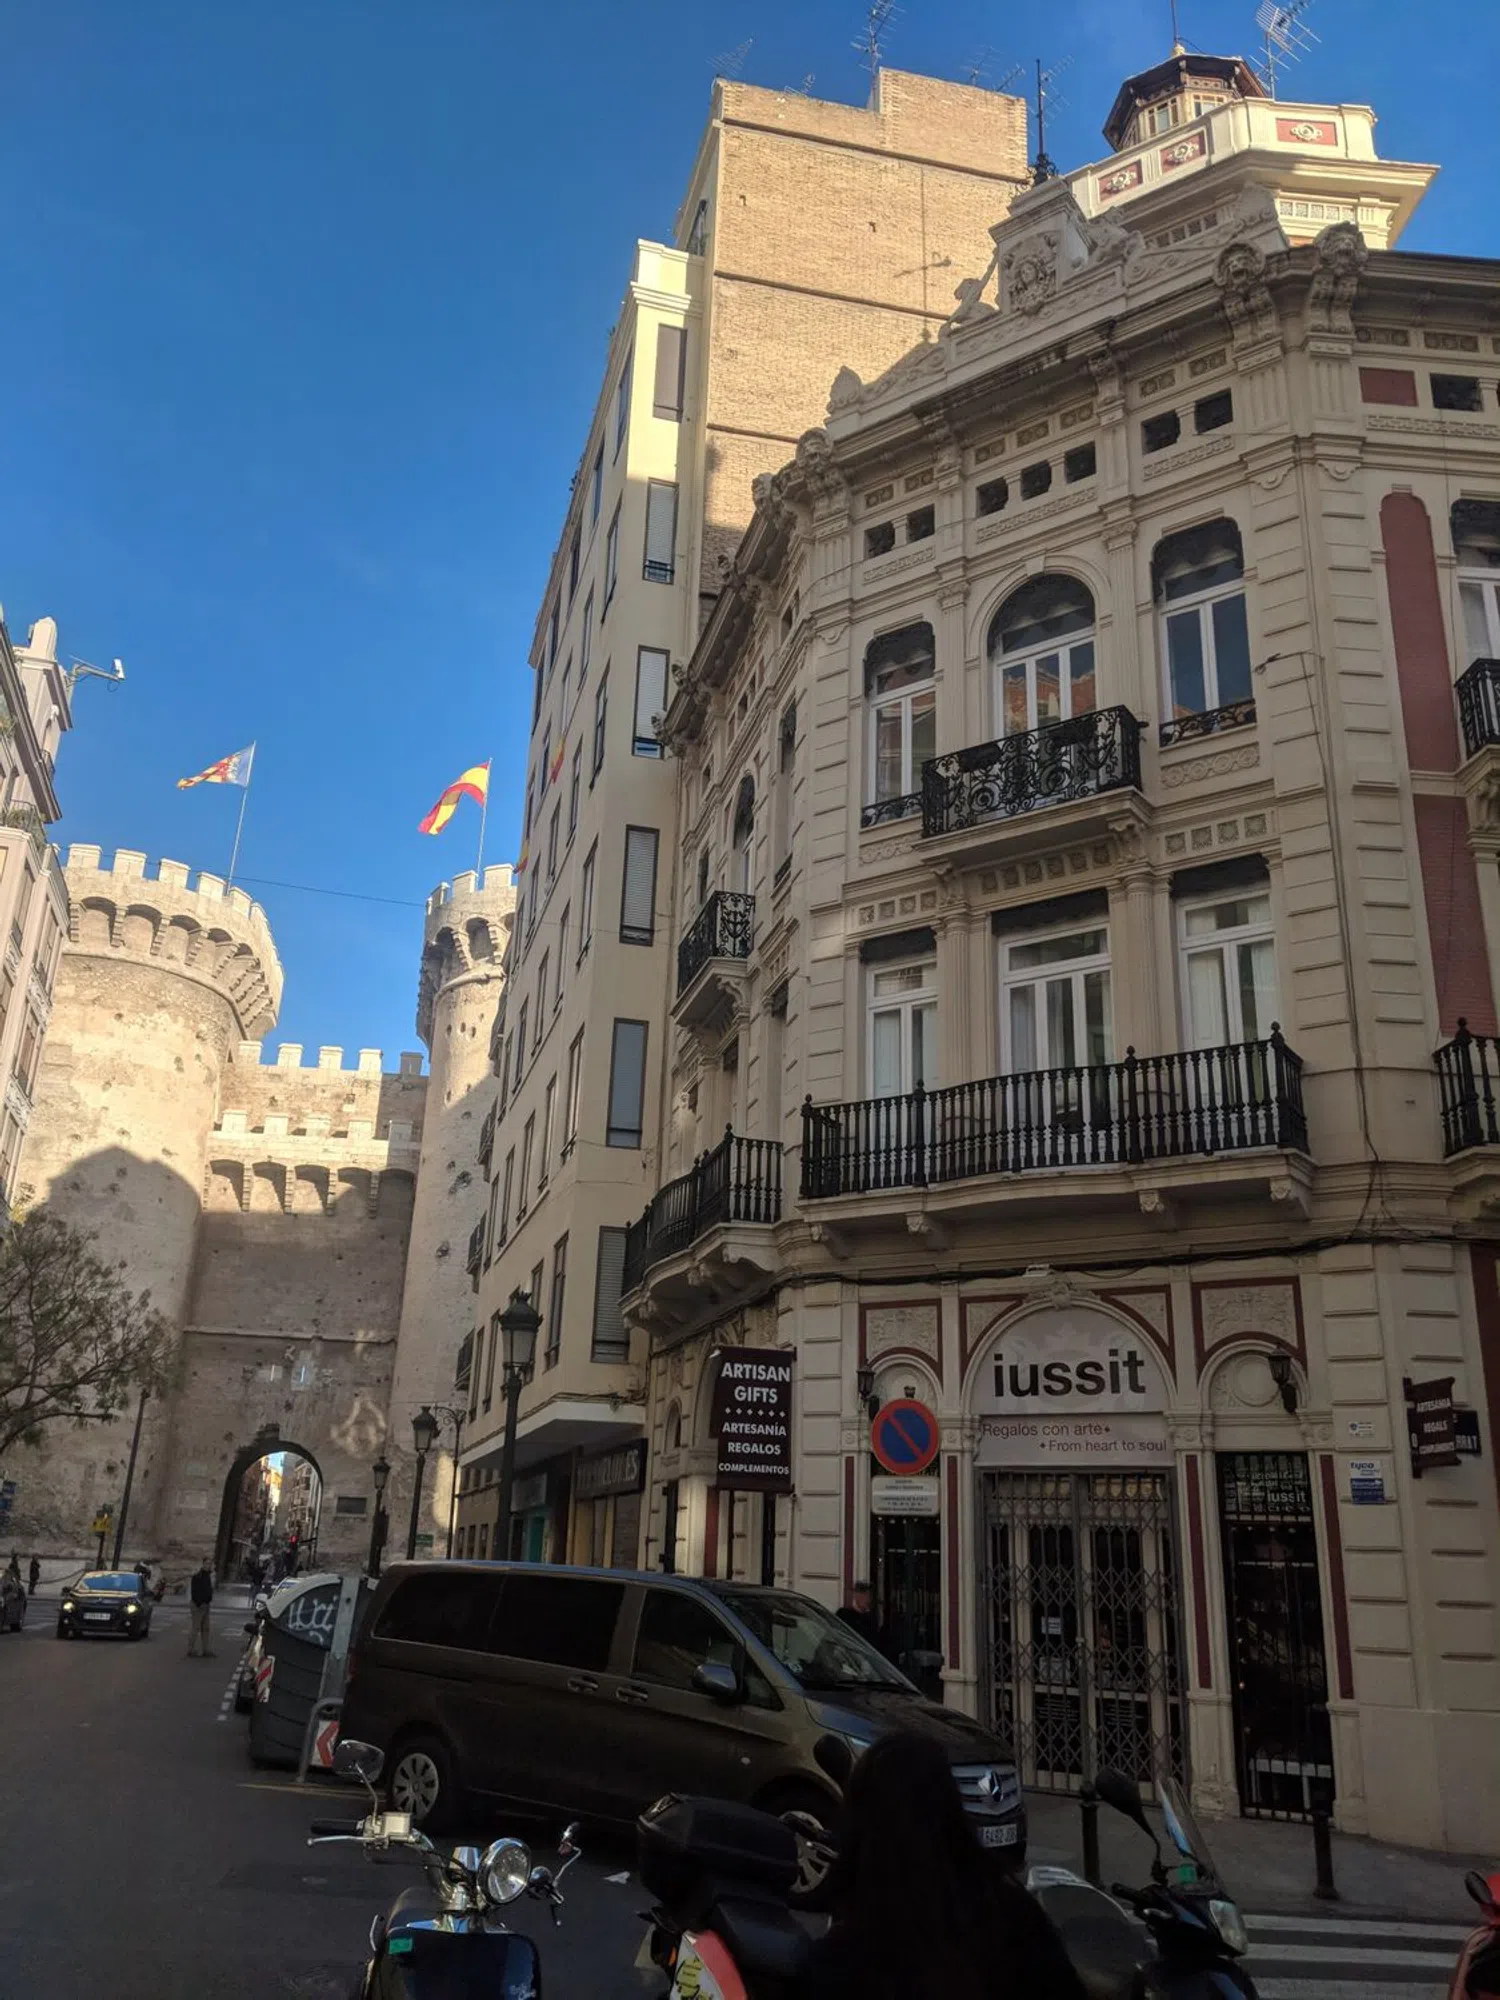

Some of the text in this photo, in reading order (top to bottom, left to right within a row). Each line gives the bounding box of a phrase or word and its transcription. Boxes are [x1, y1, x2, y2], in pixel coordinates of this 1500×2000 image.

[721, 1362, 790, 1382] ARTISAN
[994, 1349, 1146, 1397] iussit
[734, 1386, 778, 1404] GIFTS
[722, 1422, 787, 1436] ARTESANÍA
[982, 1423, 1103, 1439] Regalos con arte
[727, 1442, 781, 1455] REGALOS
[1049, 1439, 1167, 1452] From heart to soul
[718, 1462, 789, 1475] COMPLEMENTOS
[1350, 1461, 1374, 1469] tyco
